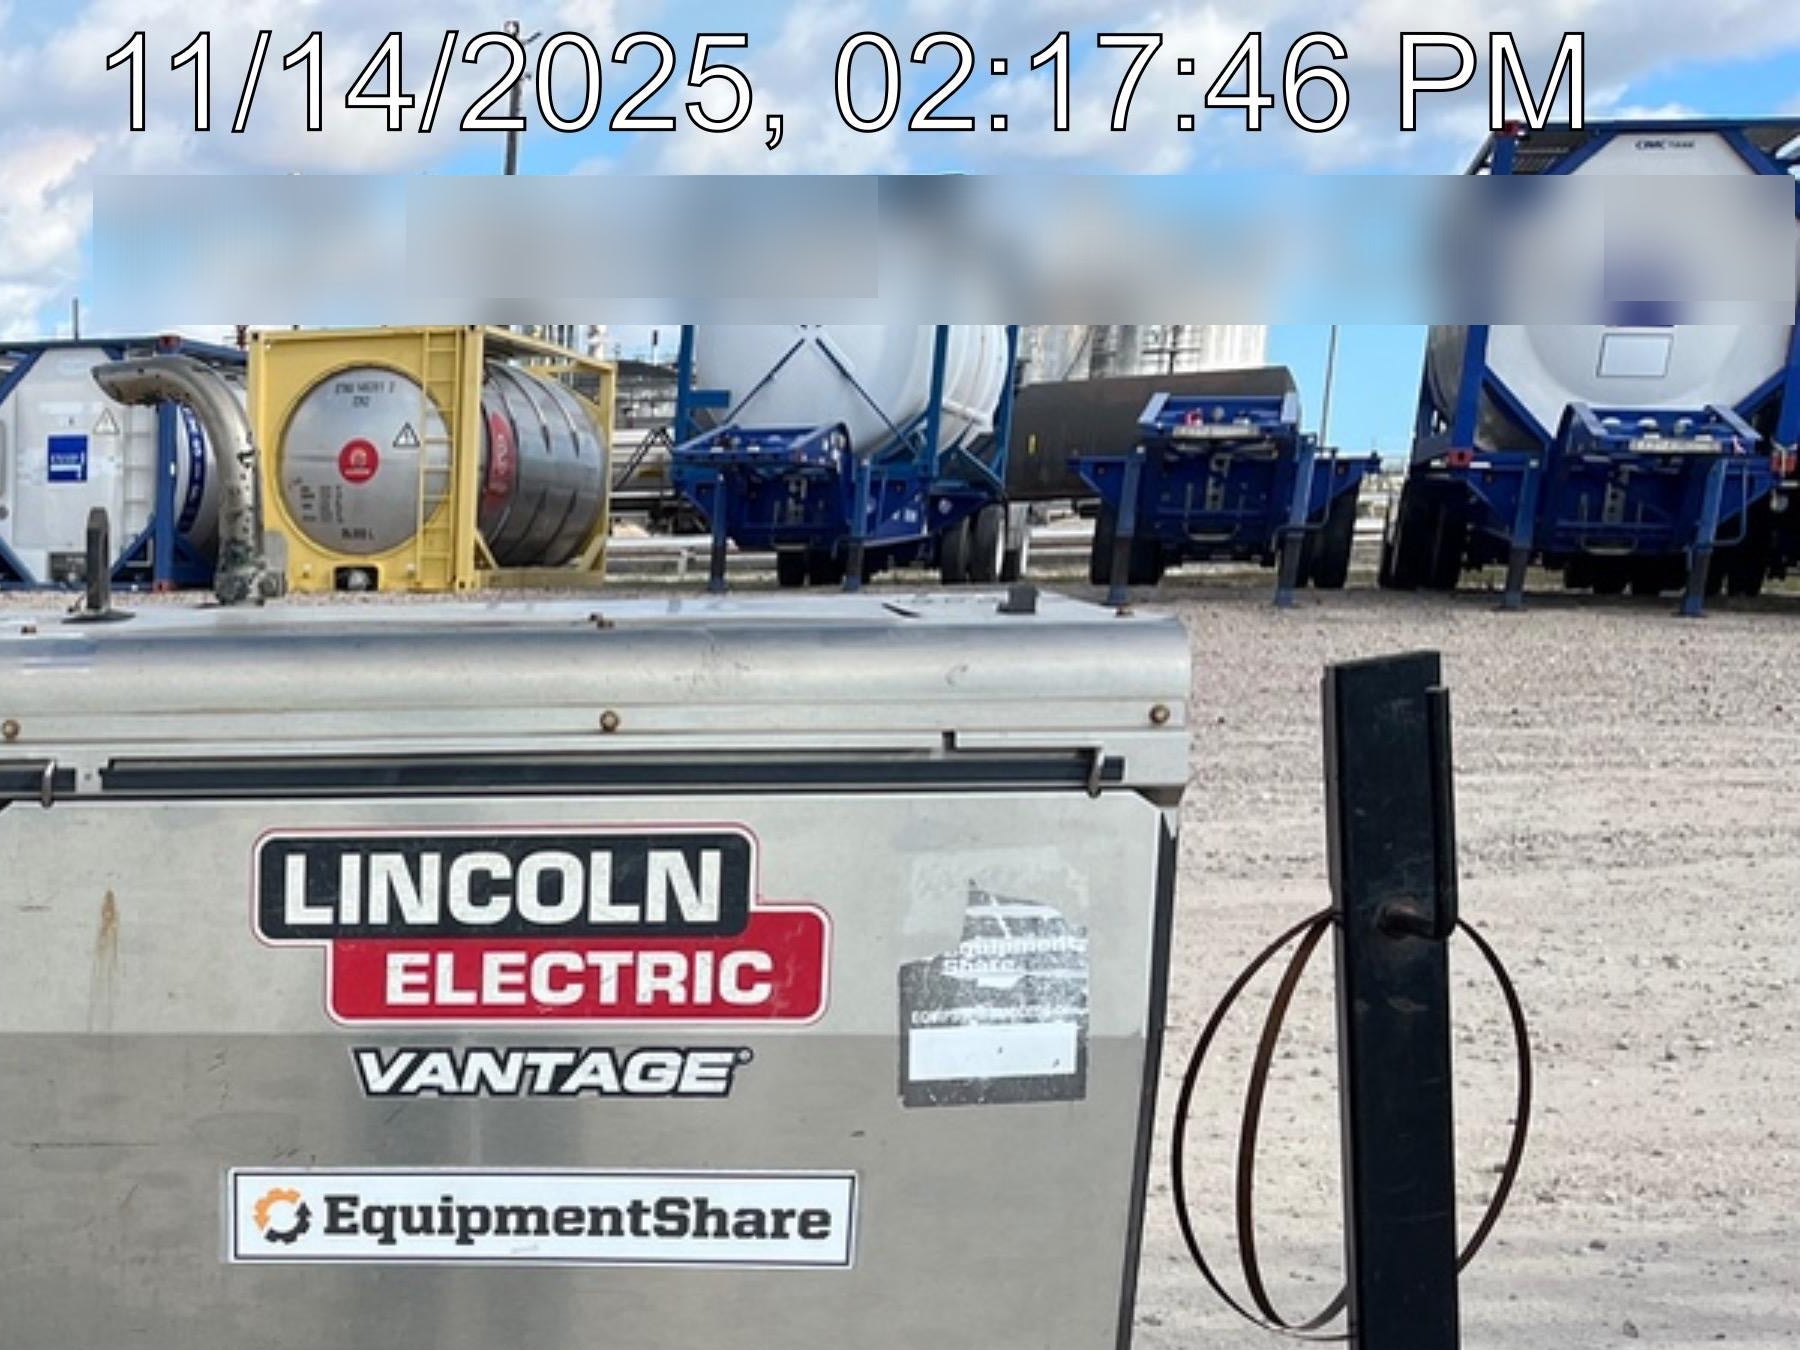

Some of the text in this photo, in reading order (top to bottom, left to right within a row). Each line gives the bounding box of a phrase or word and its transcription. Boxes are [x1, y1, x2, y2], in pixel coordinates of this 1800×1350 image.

[284, 849, 721, 926] LINCOLN
[385, 950, 773, 1006] ELECTRIC
[323, 1195, 832, 1246] EquipmentShare
